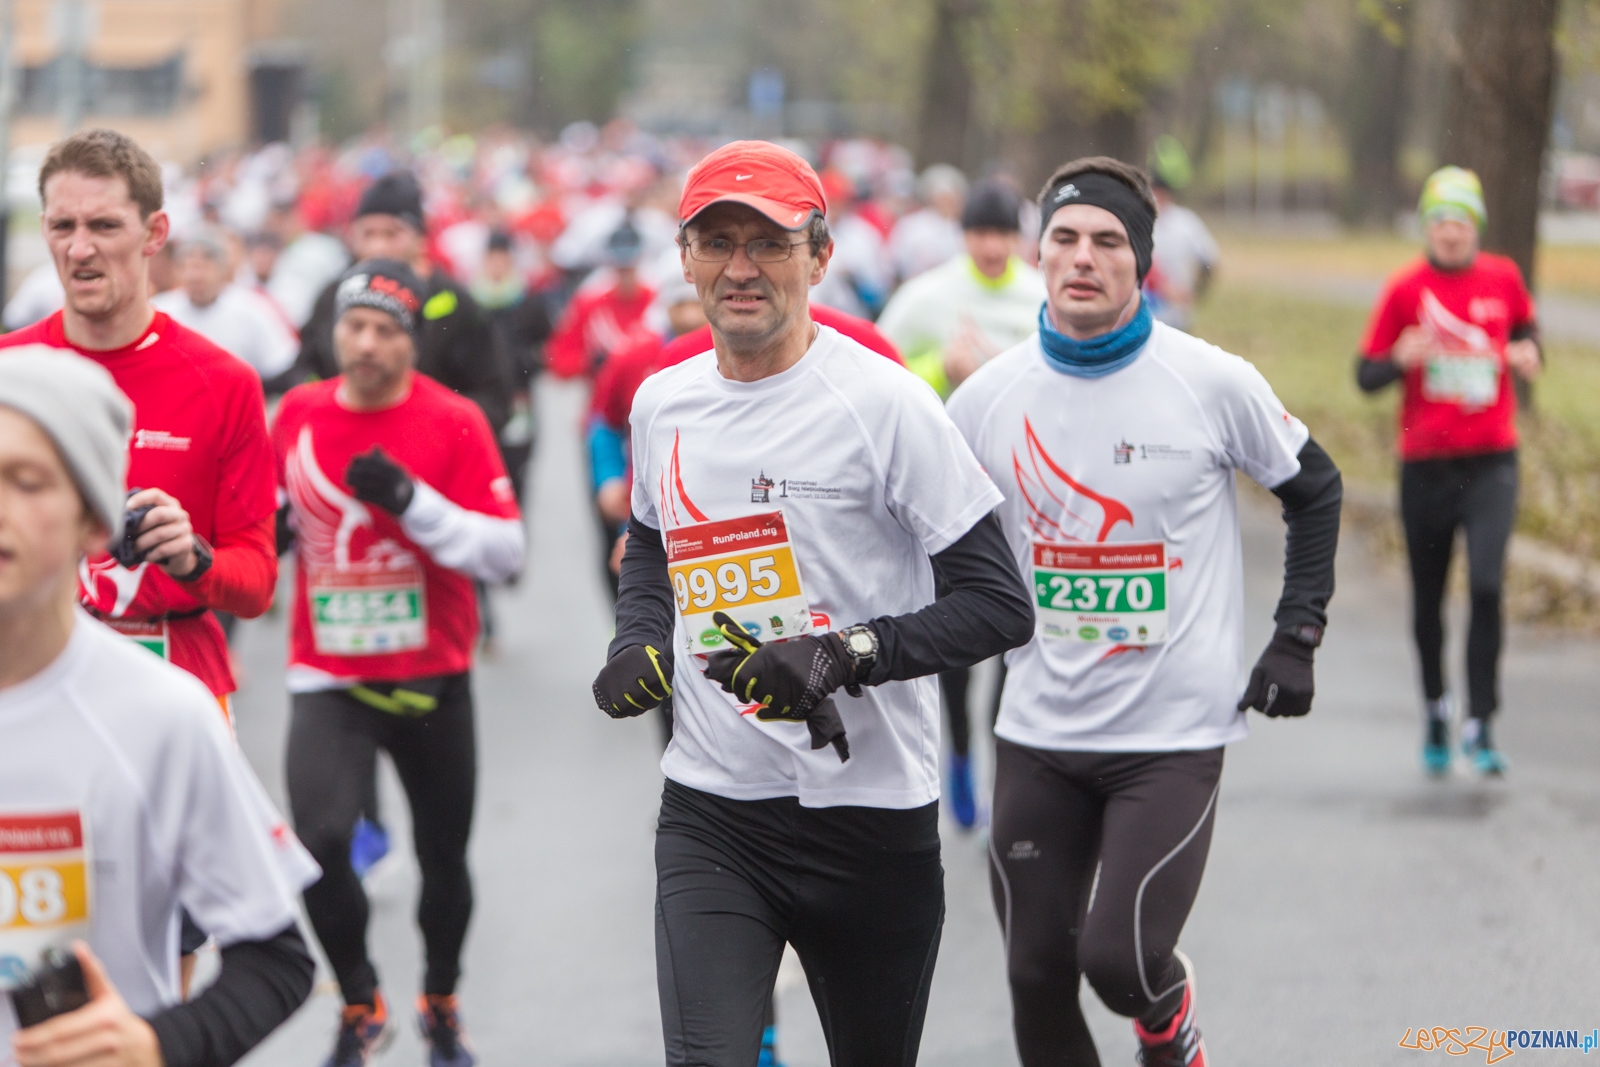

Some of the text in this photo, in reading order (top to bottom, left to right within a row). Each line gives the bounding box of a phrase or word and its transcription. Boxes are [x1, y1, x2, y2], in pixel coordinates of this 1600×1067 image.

[779, 478, 788, 498] 1
[712, 526, 778, 545] RunPoland.org
[673, 555, 783, 612] 9995
[1048, 575, 1154, 611] 2370
